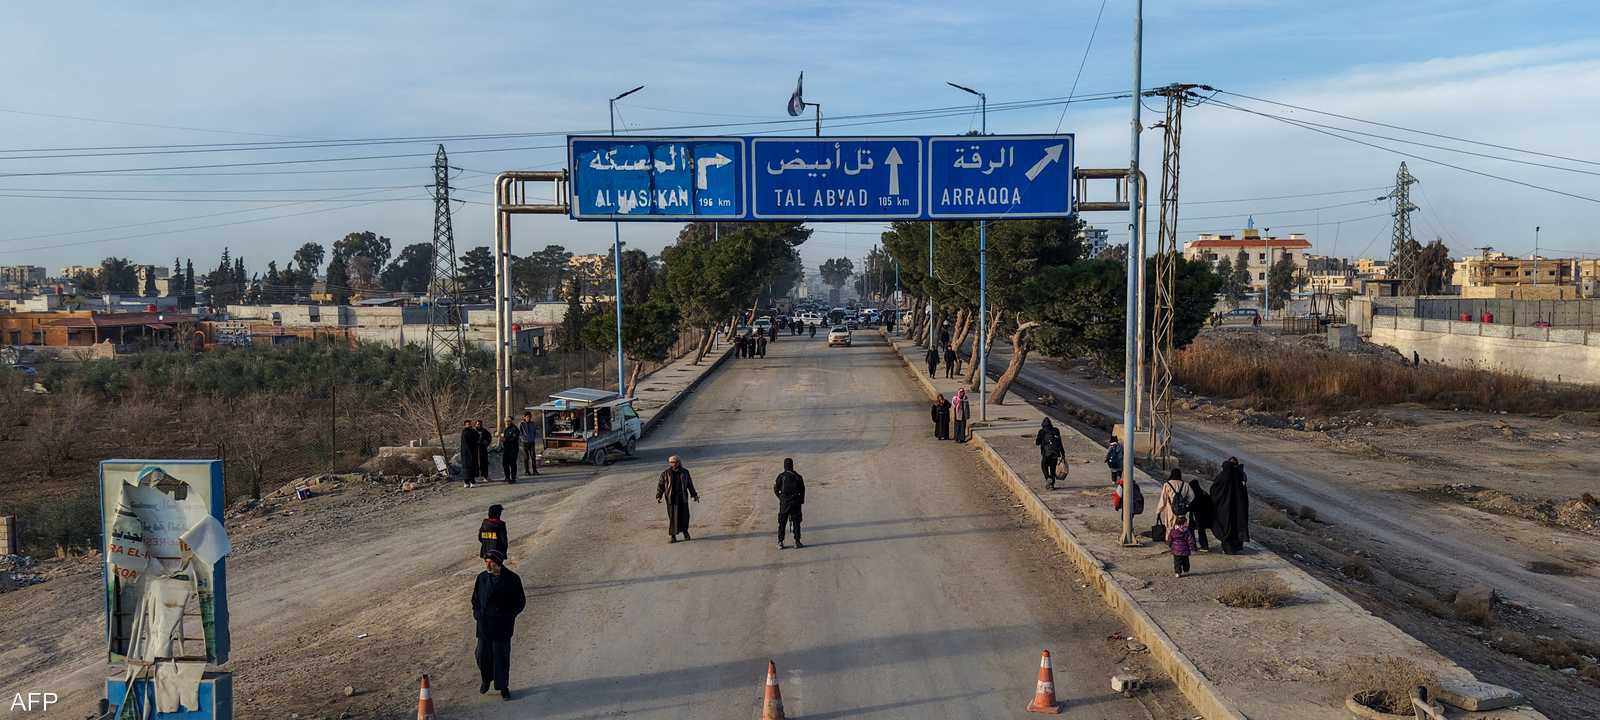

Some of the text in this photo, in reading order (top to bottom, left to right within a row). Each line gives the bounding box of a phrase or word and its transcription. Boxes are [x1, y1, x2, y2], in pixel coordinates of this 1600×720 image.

[767, 142, 874, 178] تل أبيض
[953, 145, 1014, 175] الرقة
[718, 197, 731, 207] km
[774, 189, 868, 206] TAL ABYAD
[879, 197, 910, 206] 105 km
[941, 187, 1021, 206] ARRAQQA
